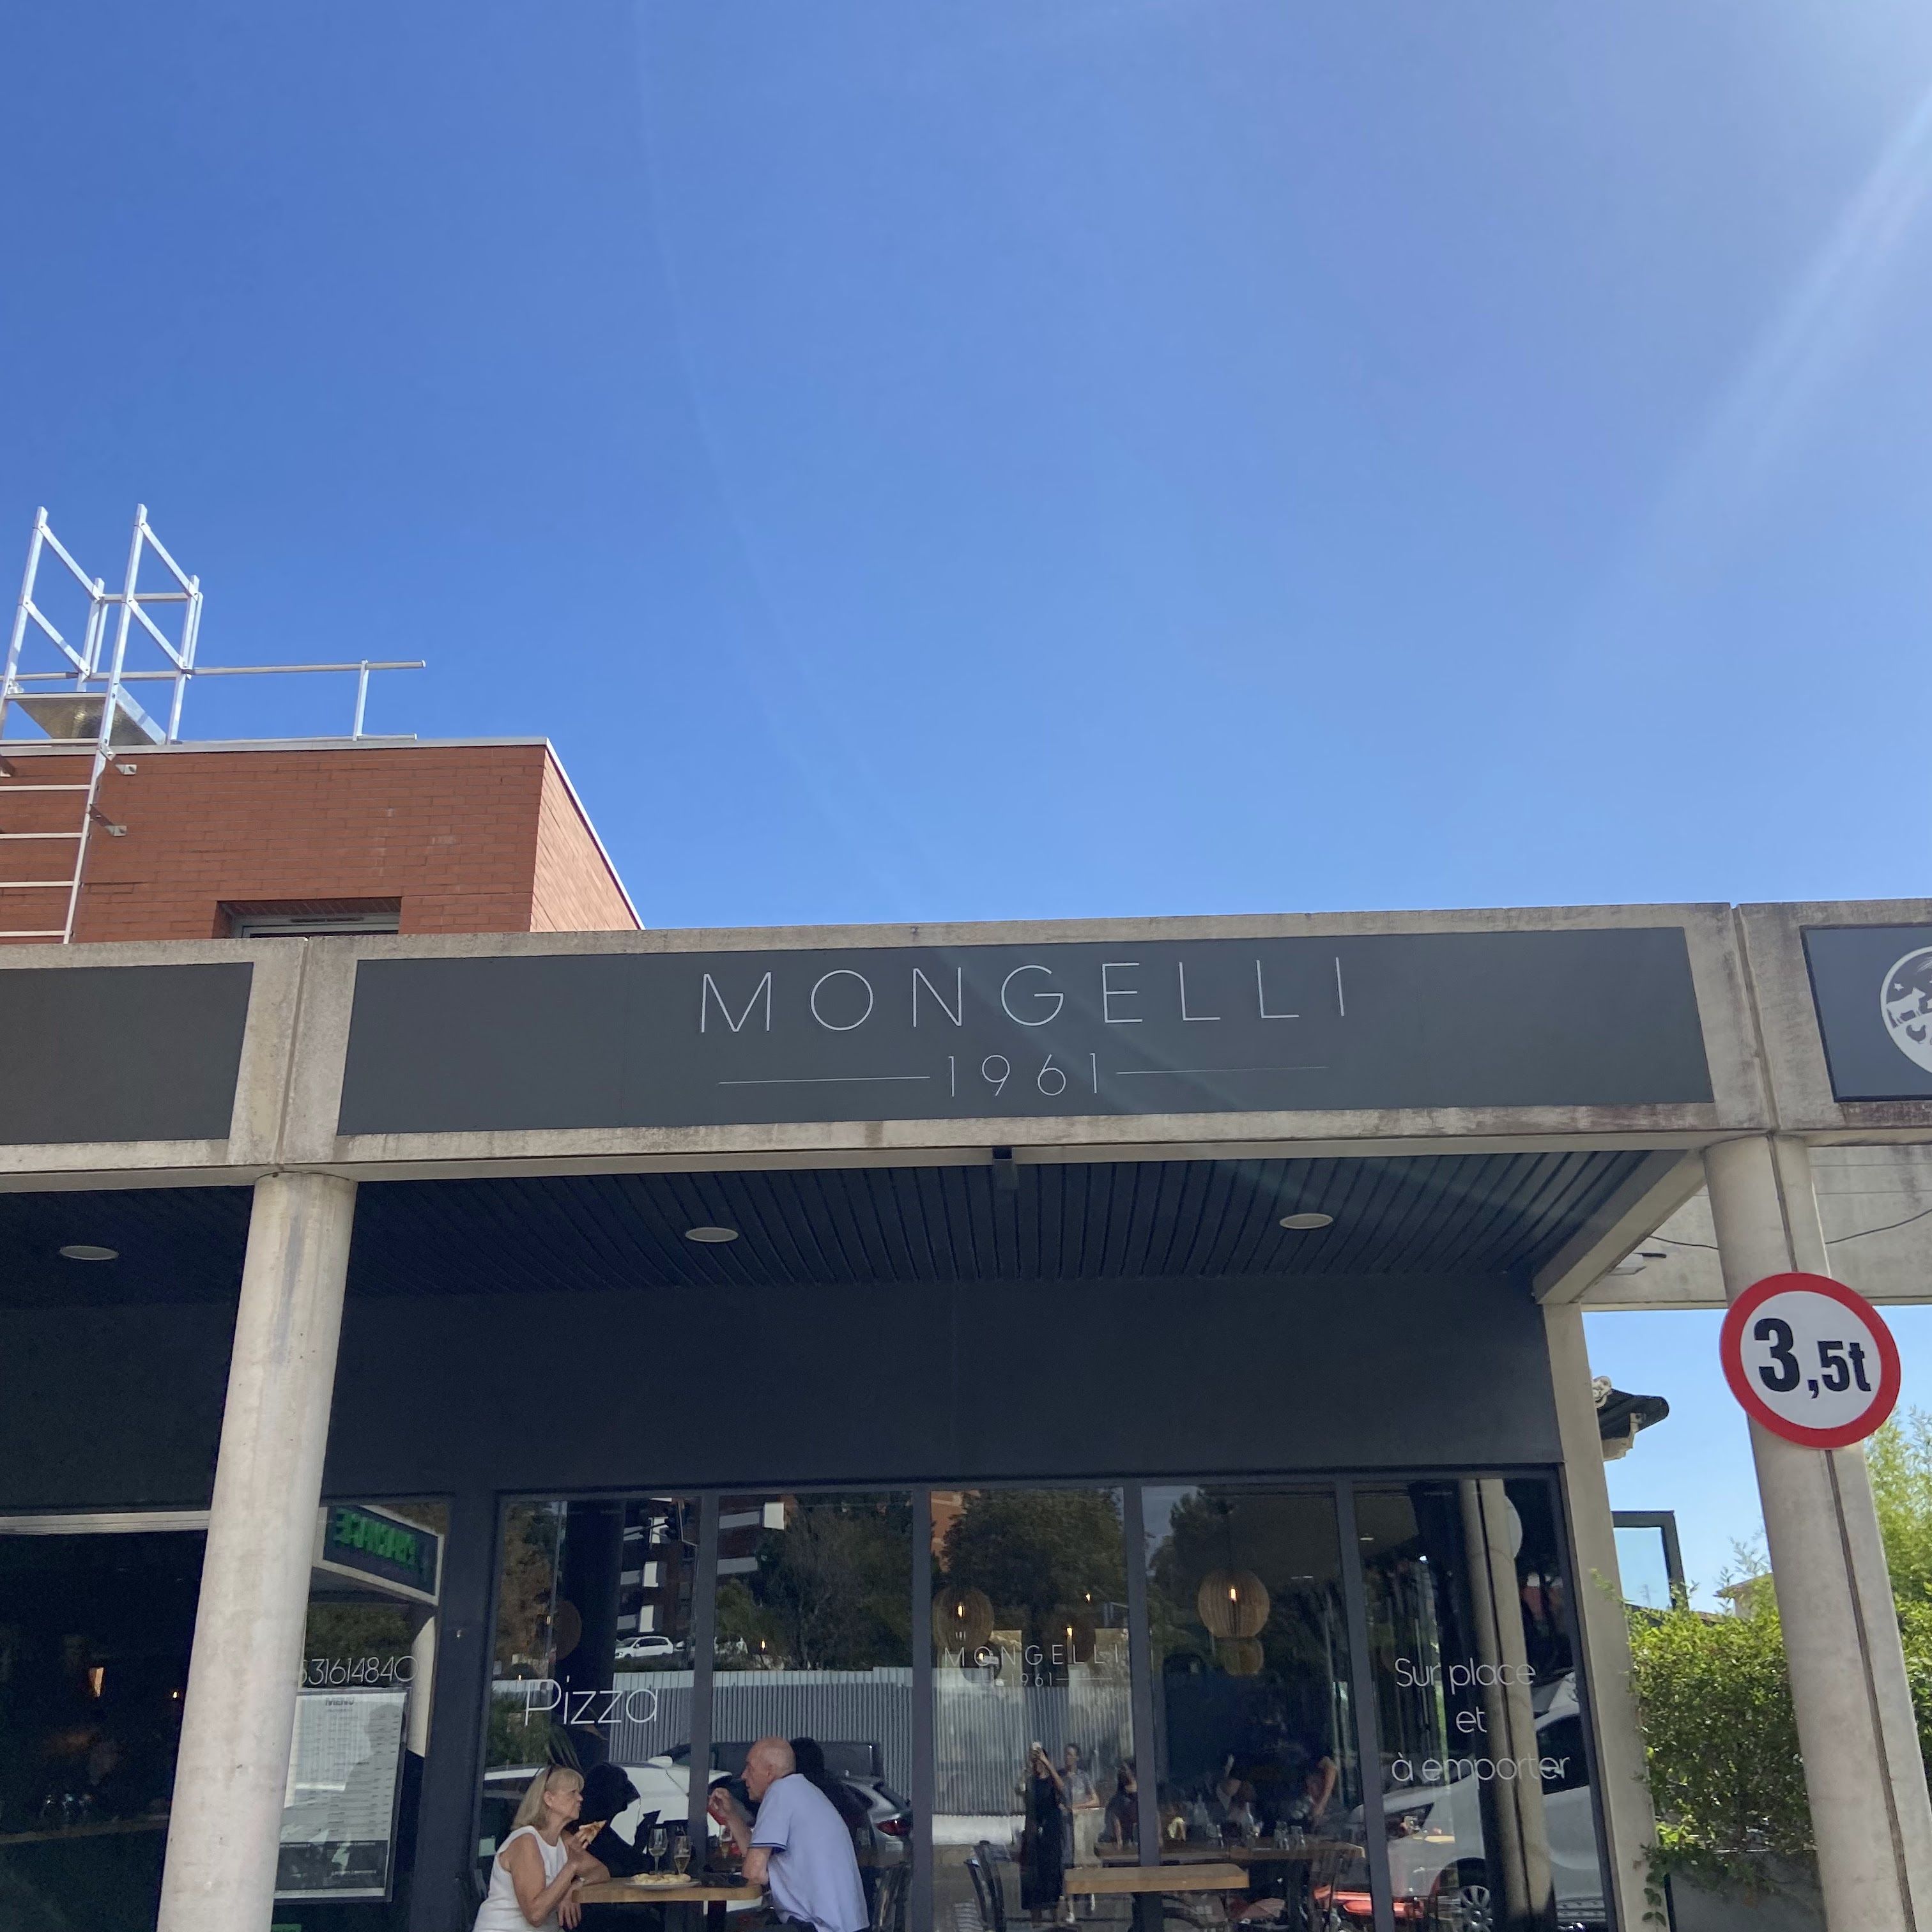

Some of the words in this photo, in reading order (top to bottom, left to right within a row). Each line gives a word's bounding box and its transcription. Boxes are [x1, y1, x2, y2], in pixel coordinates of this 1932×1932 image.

[700, 956, 1346, 1033] MONGELLI
[947, 1052, 1099, 1097] 1961
[1753, 1317, 1872, 1399] 3,5t
[944, 1643, 1119, 1667] MONGELLI
[1011, 1672, 1054, 1687] 1961
[1394, 1657, 1442, 1687] Sur
[1448, 1657, 1537, 1696] place
[524, 1675, 659, 1727] Pizza
[1455, 1706, 1488, 1734] et
[1391, 1751, 1414, 1782] à
[1421, 1753, 1571, 1790] emporter
